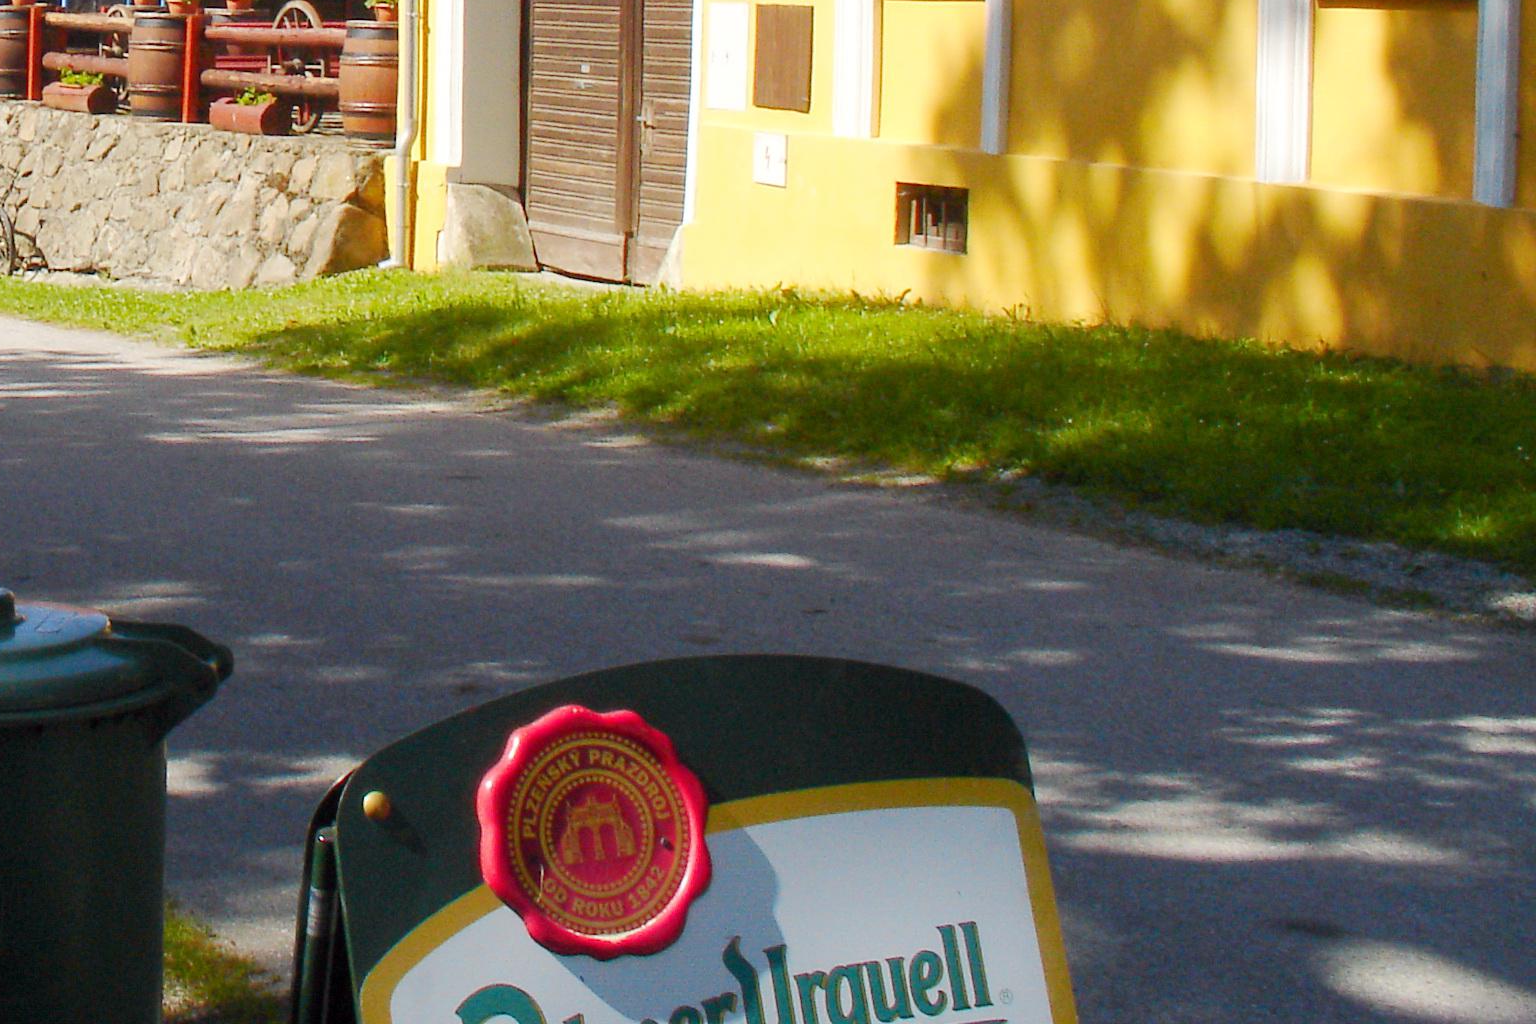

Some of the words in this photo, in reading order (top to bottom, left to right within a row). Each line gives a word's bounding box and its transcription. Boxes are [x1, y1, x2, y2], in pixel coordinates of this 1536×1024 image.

[589, 749, 671, 821] PRAZDROJ
[544, 877, 567, 904] OD
[572, 898, 624, 919] ROKU
[627, 865, 664, 907] 1842
